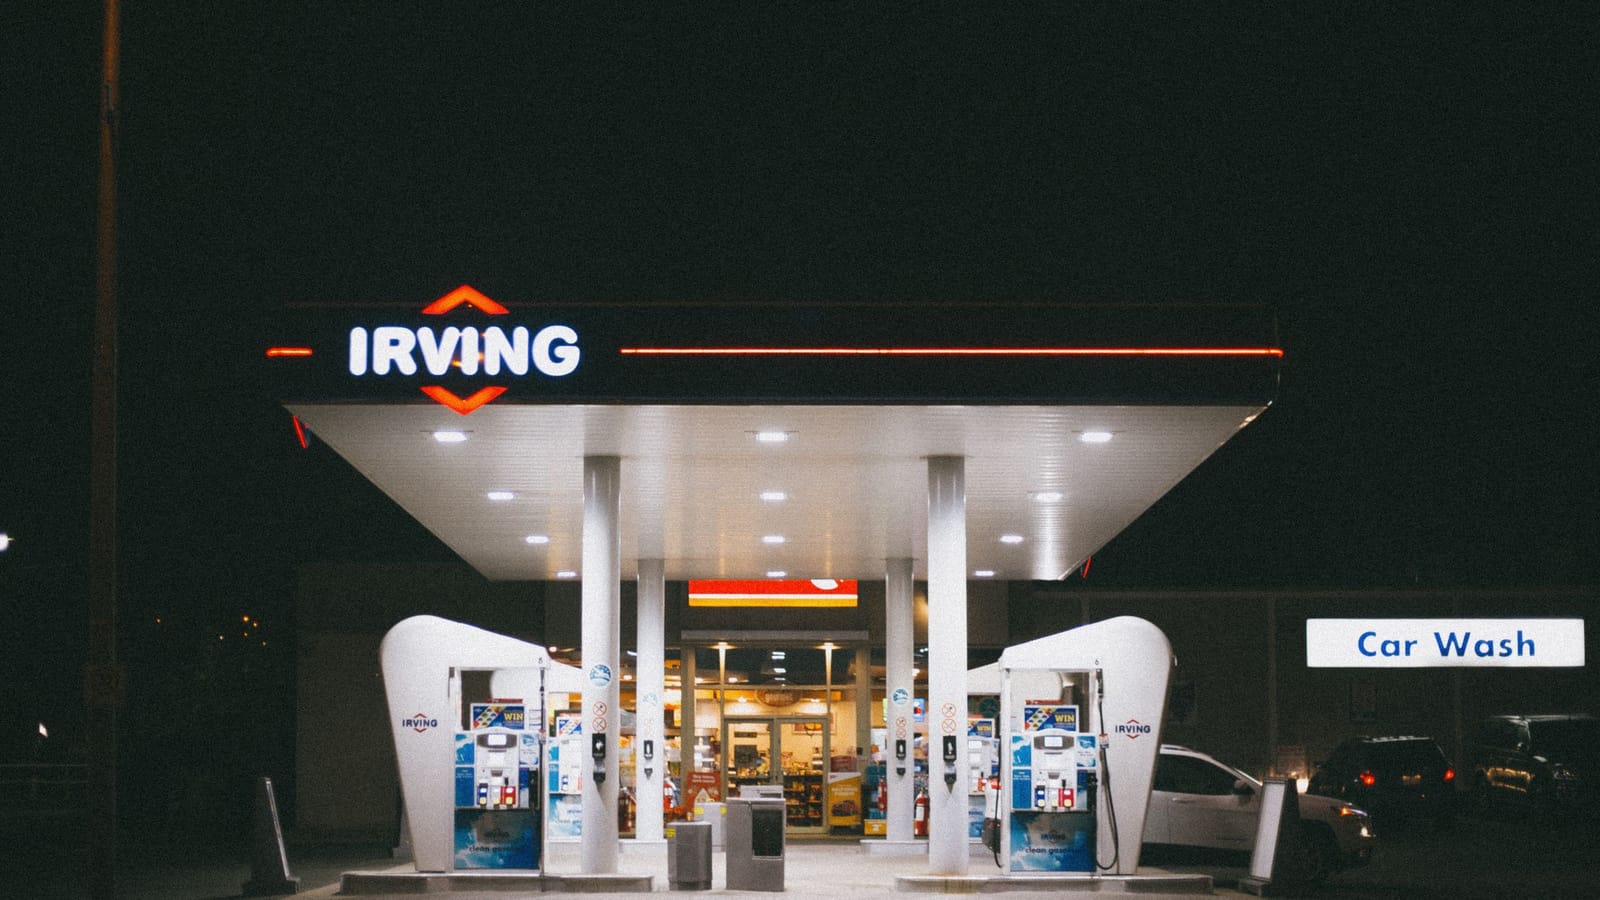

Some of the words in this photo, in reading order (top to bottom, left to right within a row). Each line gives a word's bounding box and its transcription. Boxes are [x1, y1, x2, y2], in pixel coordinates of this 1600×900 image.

[350, 325, 580, 376] IRVING
[1358, 631, 1417, 657] Car
[1434, 630, 1535, 657] Wash
[504, 712, 523, 721] WIN
[1054, 714, 1075, 723] WIN
[402, 719, 438, 728] IRVING
[1115, 725, 1151, 734] IRVING
